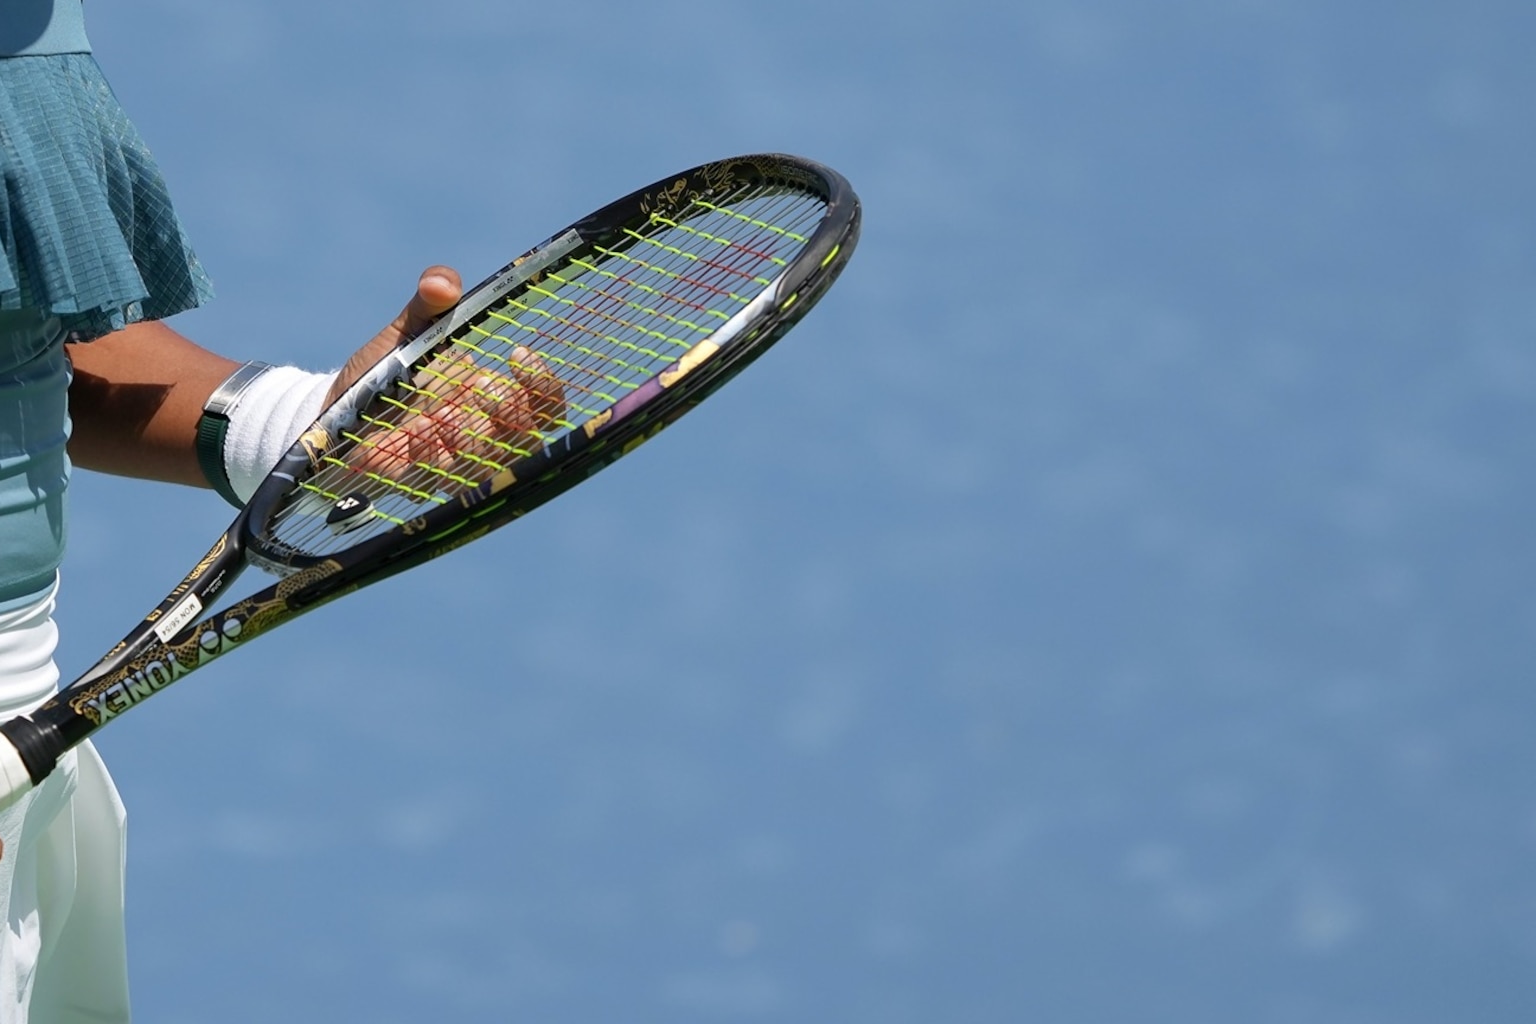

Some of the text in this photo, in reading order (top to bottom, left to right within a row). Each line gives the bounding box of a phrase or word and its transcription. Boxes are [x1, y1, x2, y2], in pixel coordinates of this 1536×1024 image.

[162, 603, 196, 636] MON 56/54
[85, 652, 191, 724] YONEX
